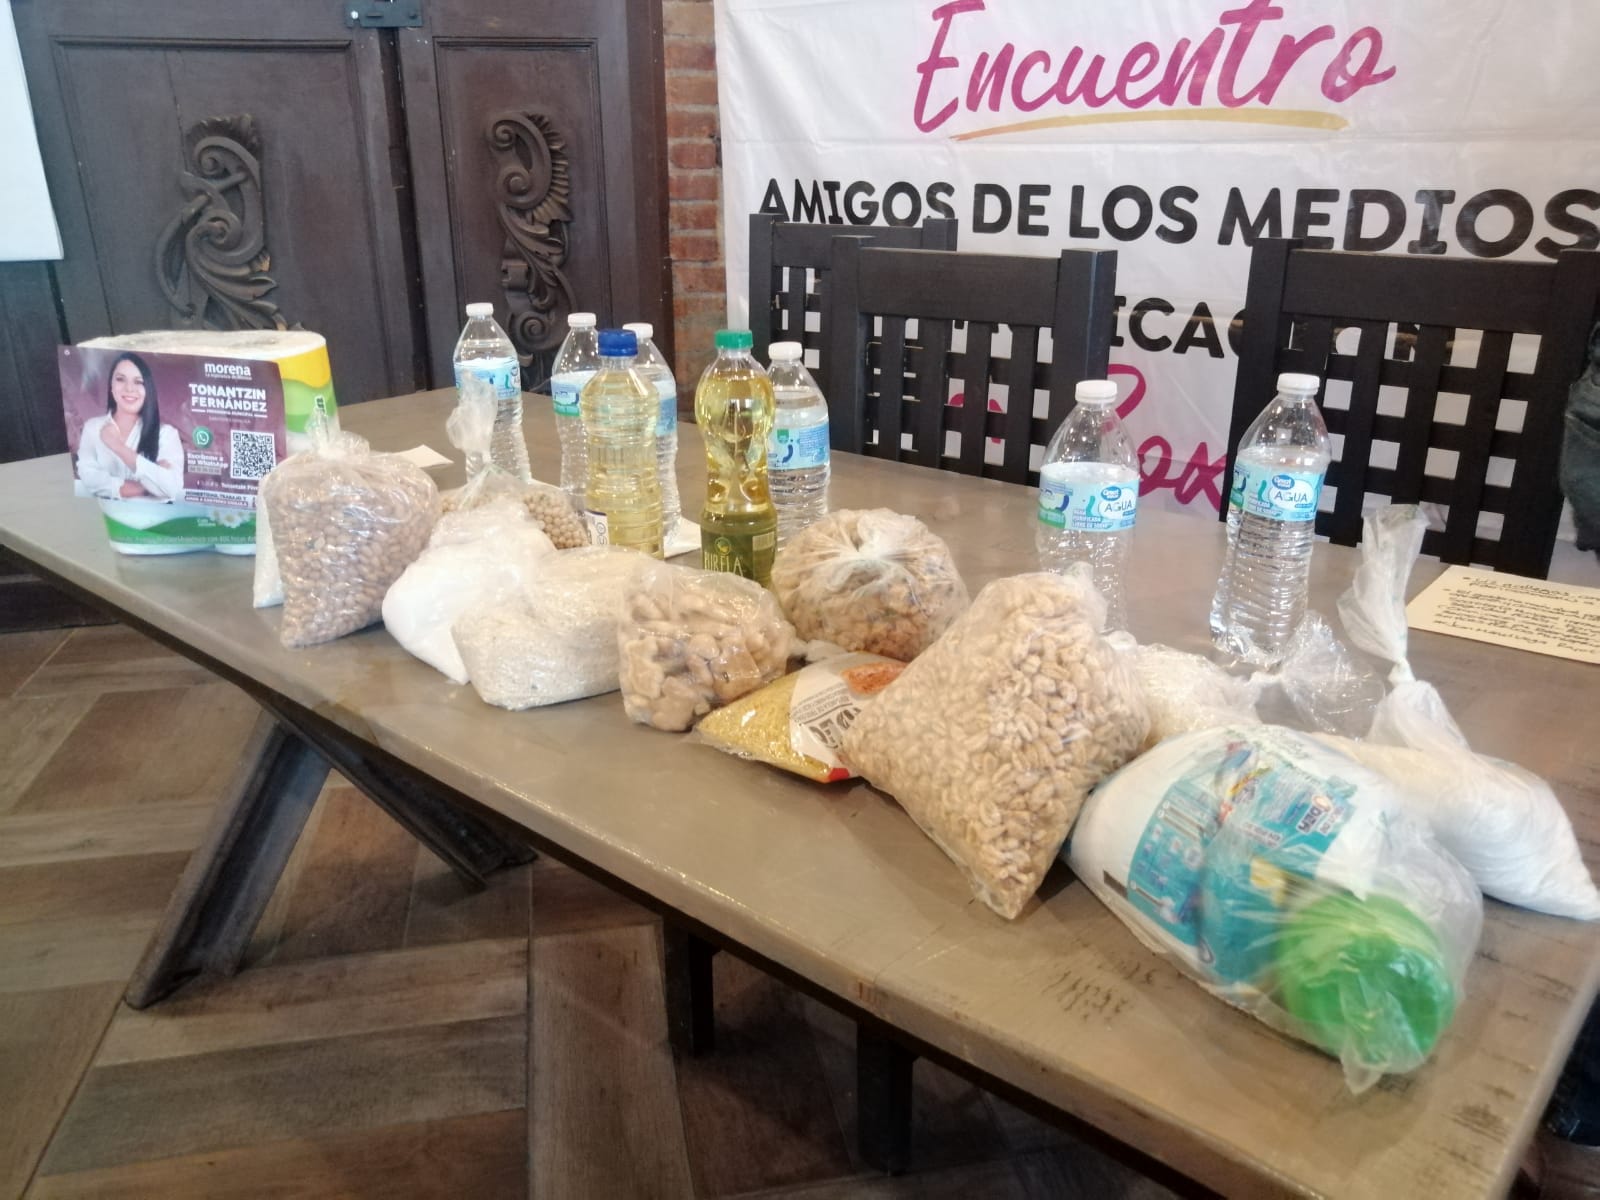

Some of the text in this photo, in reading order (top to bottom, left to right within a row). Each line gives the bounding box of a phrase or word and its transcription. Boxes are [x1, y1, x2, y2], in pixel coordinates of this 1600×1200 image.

[913, 0, 1397, 134] Encuentro
[758, 178, 1600, 260] AMIGOS DE LOS MEDIOS
[204, 362, 252, 377] morena
[188, 383, 267, 401] TONANTZIN
[191, 395, 268, 413] FERNÁNDEZ
[1274, 490, 1308, 503] AGUA
[1104, 500, 1133, 513] AGUA
